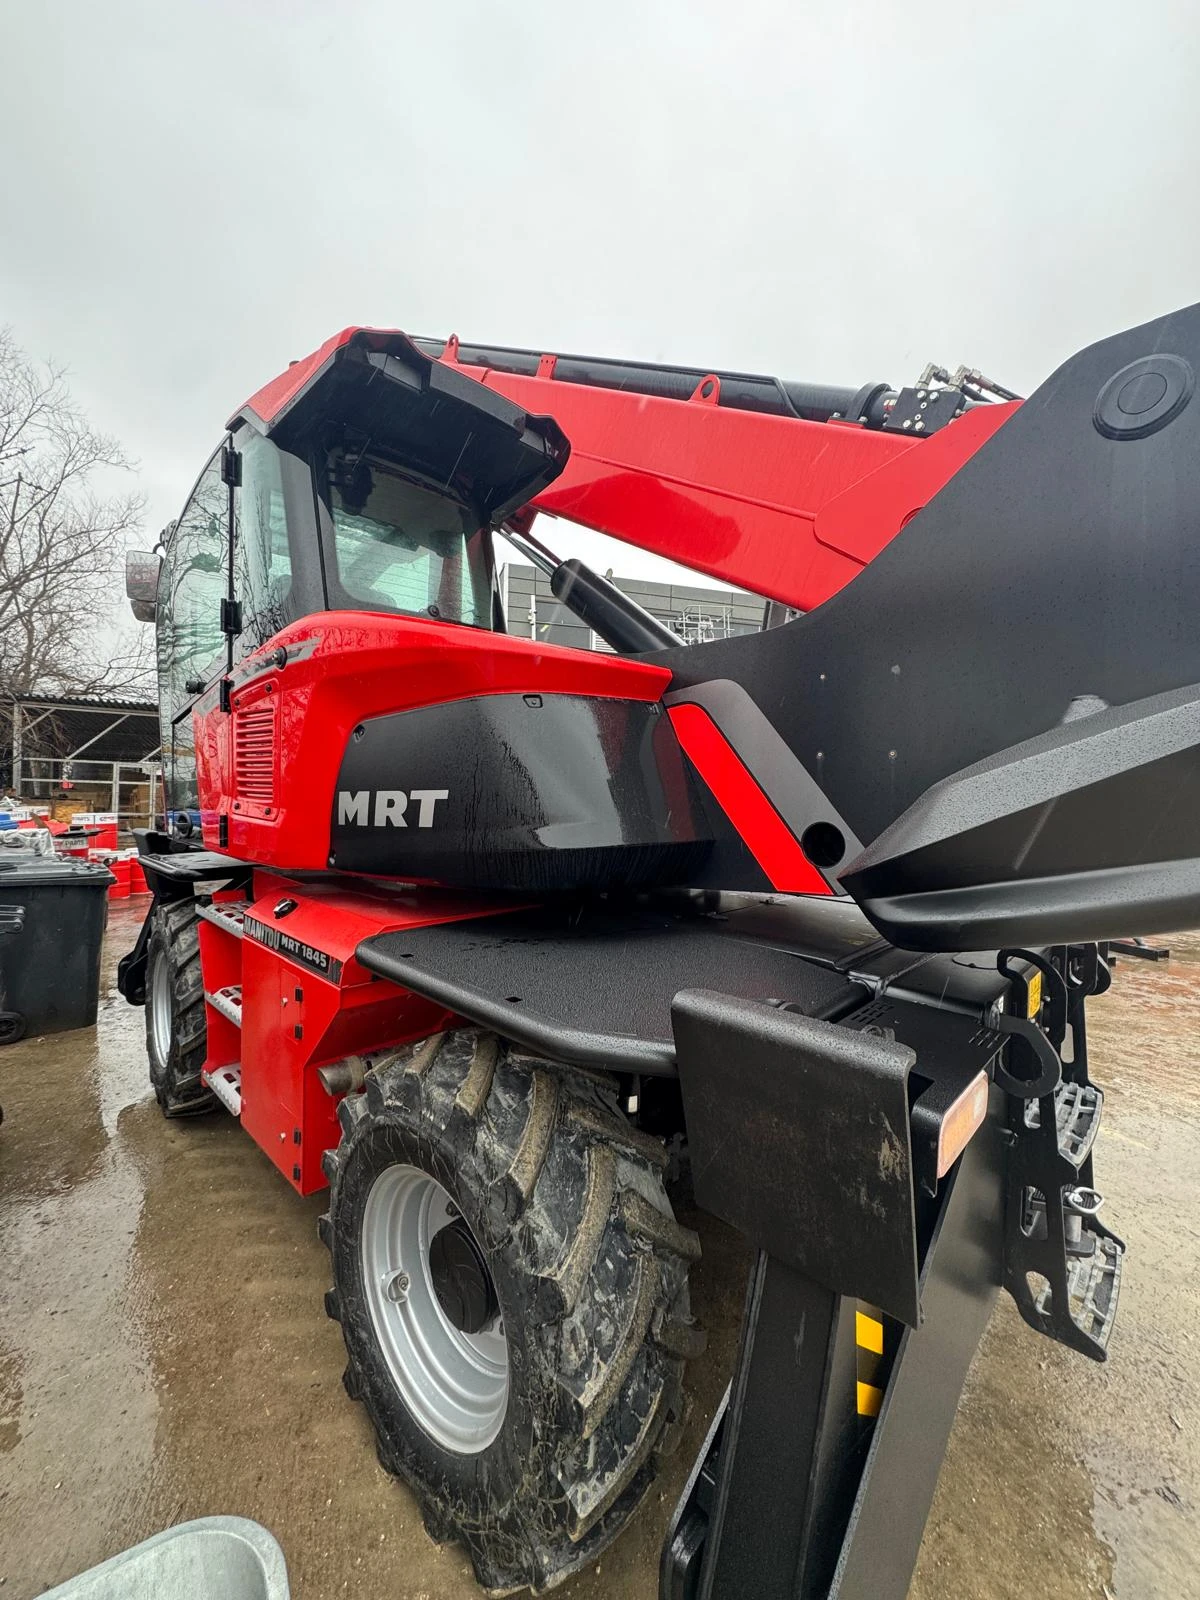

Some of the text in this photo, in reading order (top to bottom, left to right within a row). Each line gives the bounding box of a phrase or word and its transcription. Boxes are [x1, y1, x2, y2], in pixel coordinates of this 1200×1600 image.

[338, 790, 449, 827] MRT
[244, 914, 327, 969] MANITOU MRT 1845
